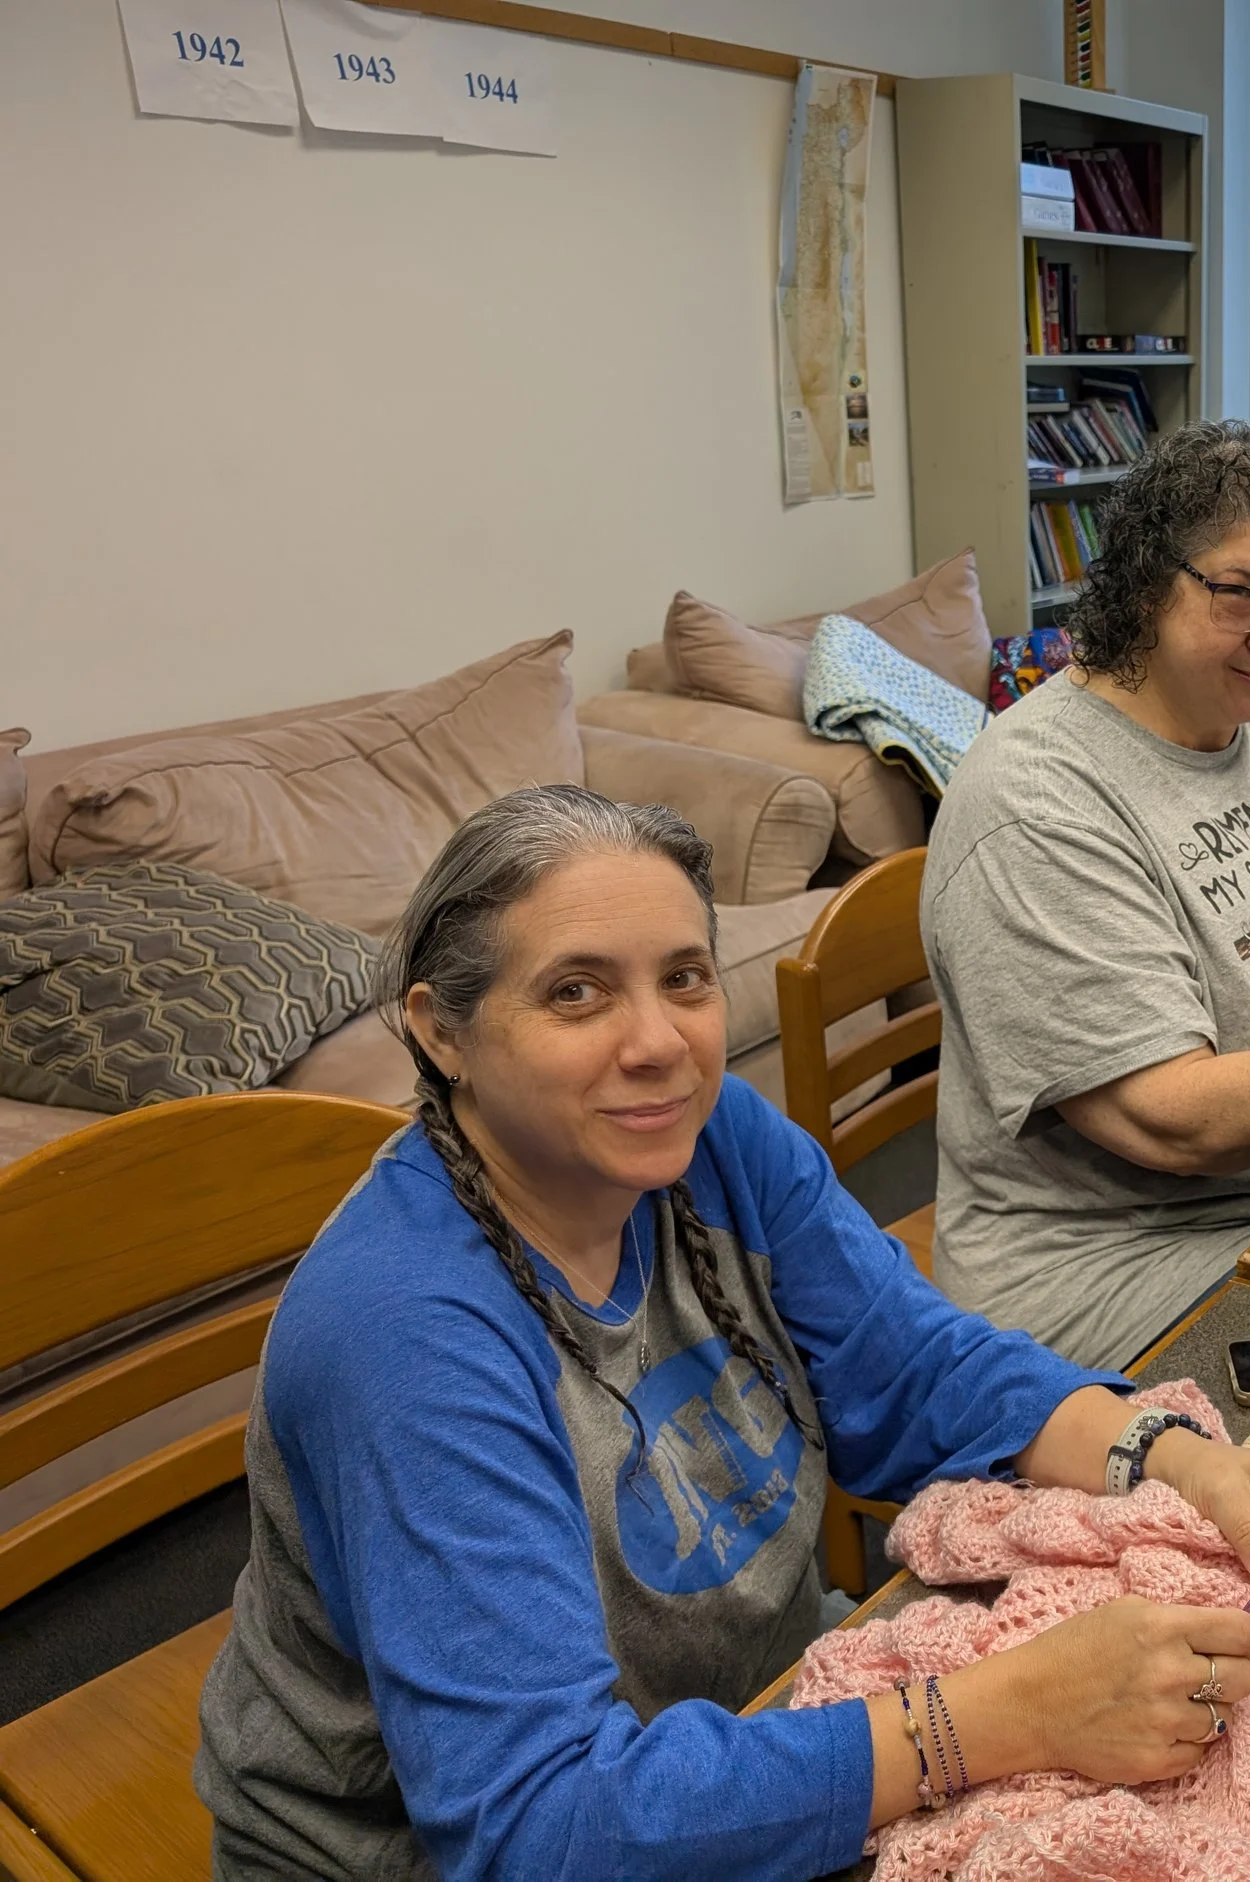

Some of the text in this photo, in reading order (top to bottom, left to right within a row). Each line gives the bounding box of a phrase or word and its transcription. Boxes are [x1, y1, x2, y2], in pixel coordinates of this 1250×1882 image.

[172, 30, 245, 68] 1942
[332, 52, 396, 85] 1943
[464, 72, 519, 104] 1944
[1200, 869, 1246, 914] MY
